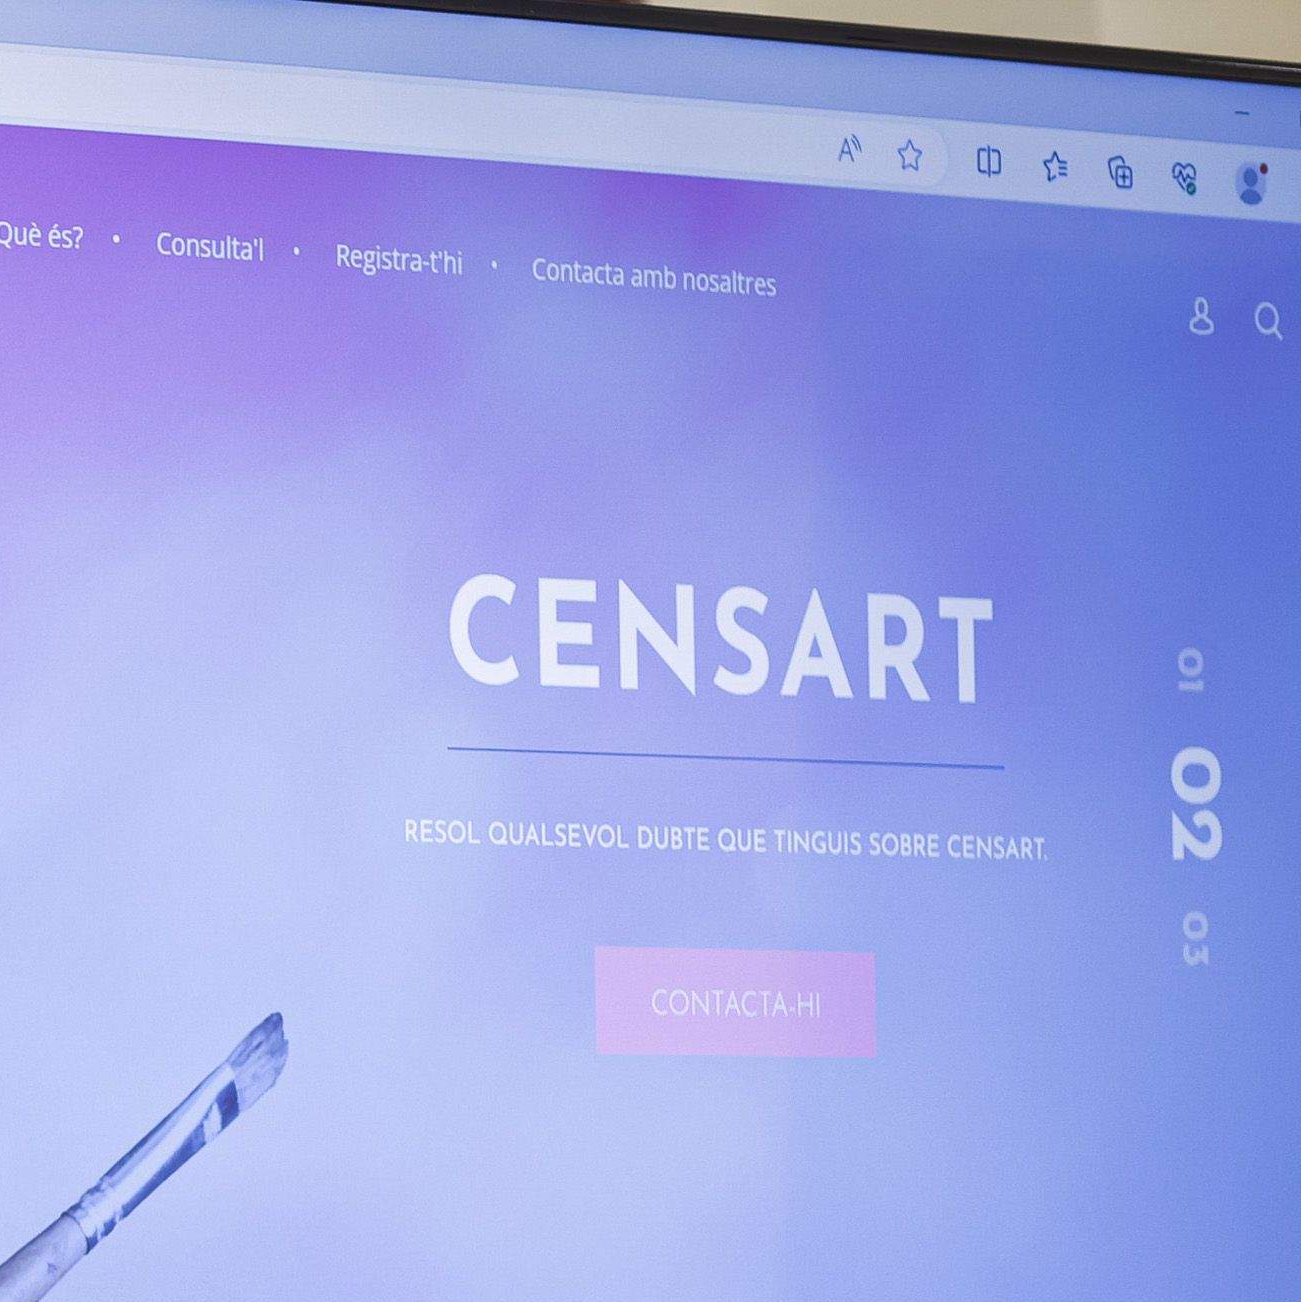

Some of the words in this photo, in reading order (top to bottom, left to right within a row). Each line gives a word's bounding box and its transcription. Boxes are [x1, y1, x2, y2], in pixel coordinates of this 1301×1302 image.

[47, 224, 84, 249] és?
[156, 231, 264, 261] Consulta'l
[336, 244, 463, 276] Registra-t'hi
[532, 257, 625, 286] Contacta
[630, 265, 677, 289] amb
[683, 270, 777, 297] nosaltres
[449, 573, 993, 704] CENSART
[1170, 746, 1223, 861] 02
[404, 818, 481, 846] RESOL
[488, 821, 629, 850] QUALSEVOL
[637, 825, 710, 853] DUBTE
[717, 828, 766, 855] QUE
[774, 829, 863, 857] TINGUIS
[868, 831, 940, 859] SOBRE
[946, 835, 1049, 862] CENSART.
